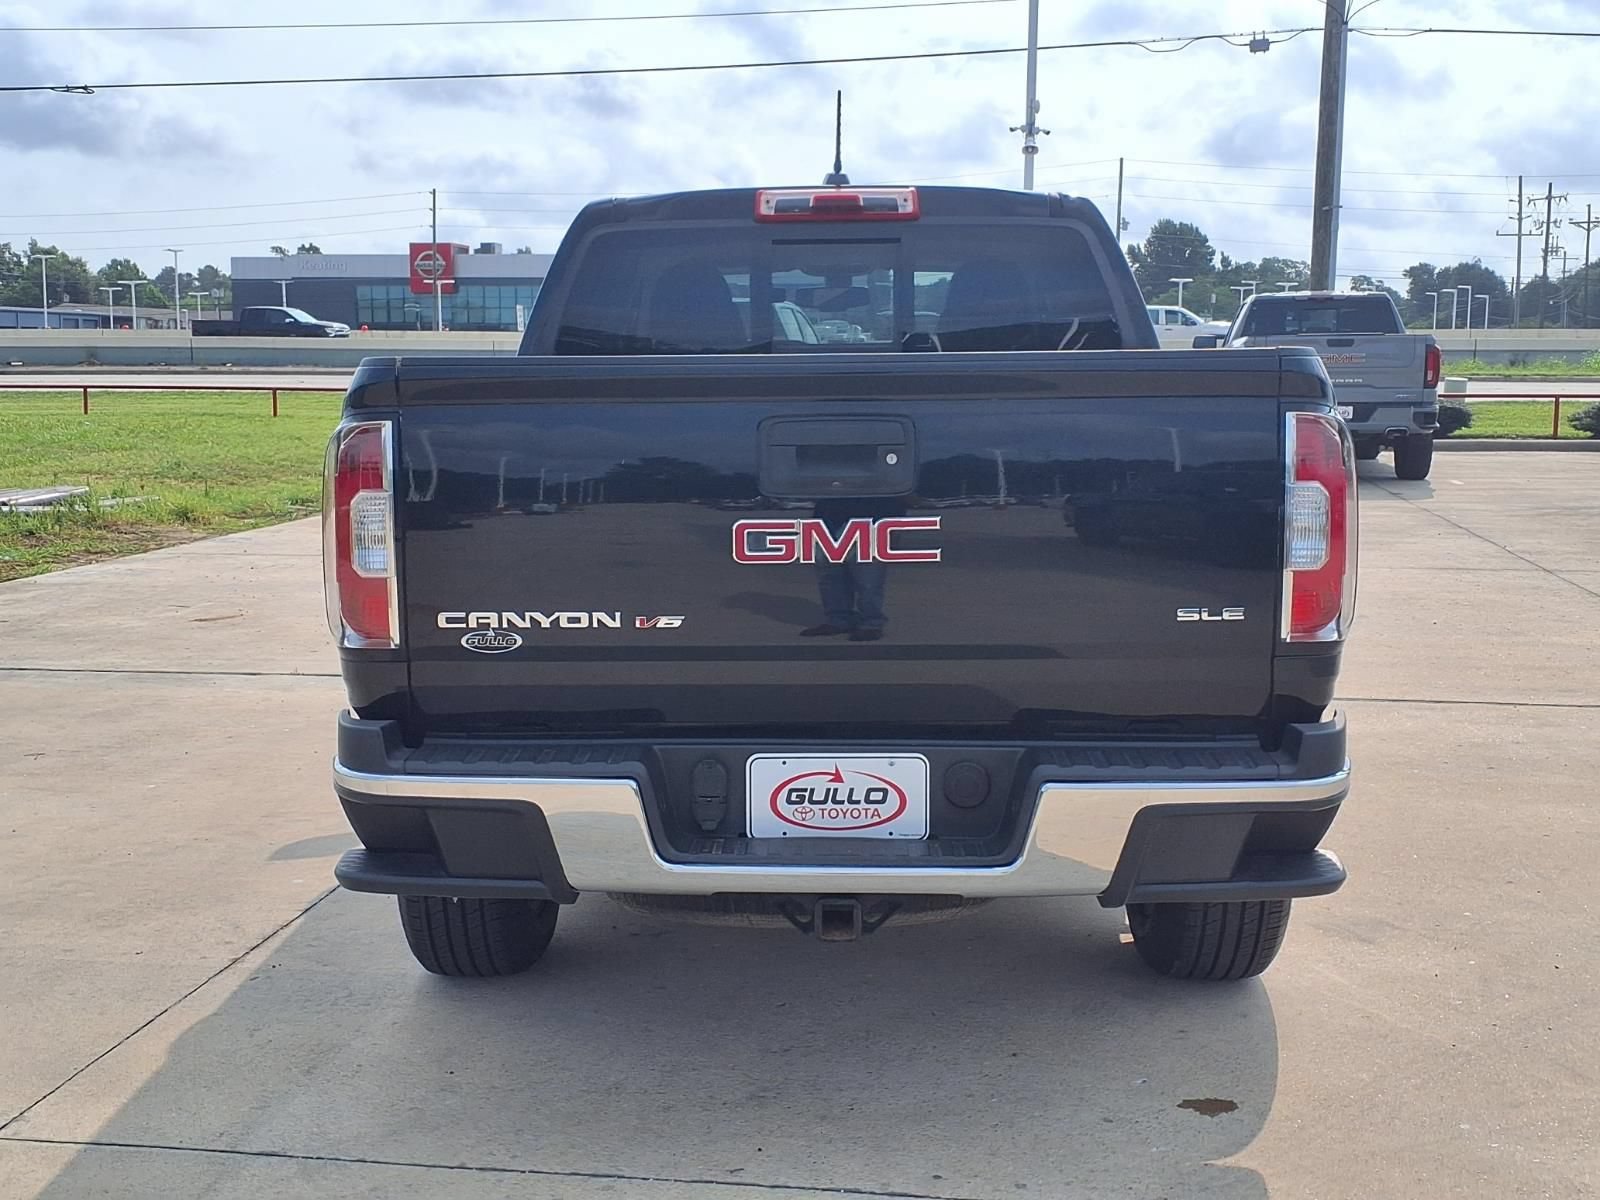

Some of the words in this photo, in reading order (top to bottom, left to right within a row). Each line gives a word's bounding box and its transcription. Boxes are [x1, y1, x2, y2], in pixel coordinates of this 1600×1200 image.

[732, 516, 941, 564] GMC
[437, 611, 621, 628] CANYON
[635, 615, 685, 628] V6
[1176, 607, 1245, 621] SLE
[465, 636, 518, 647] GULLO
[785, 787, 889, 805] GULLO
[818, 807, 882, 820] TOYOTA
